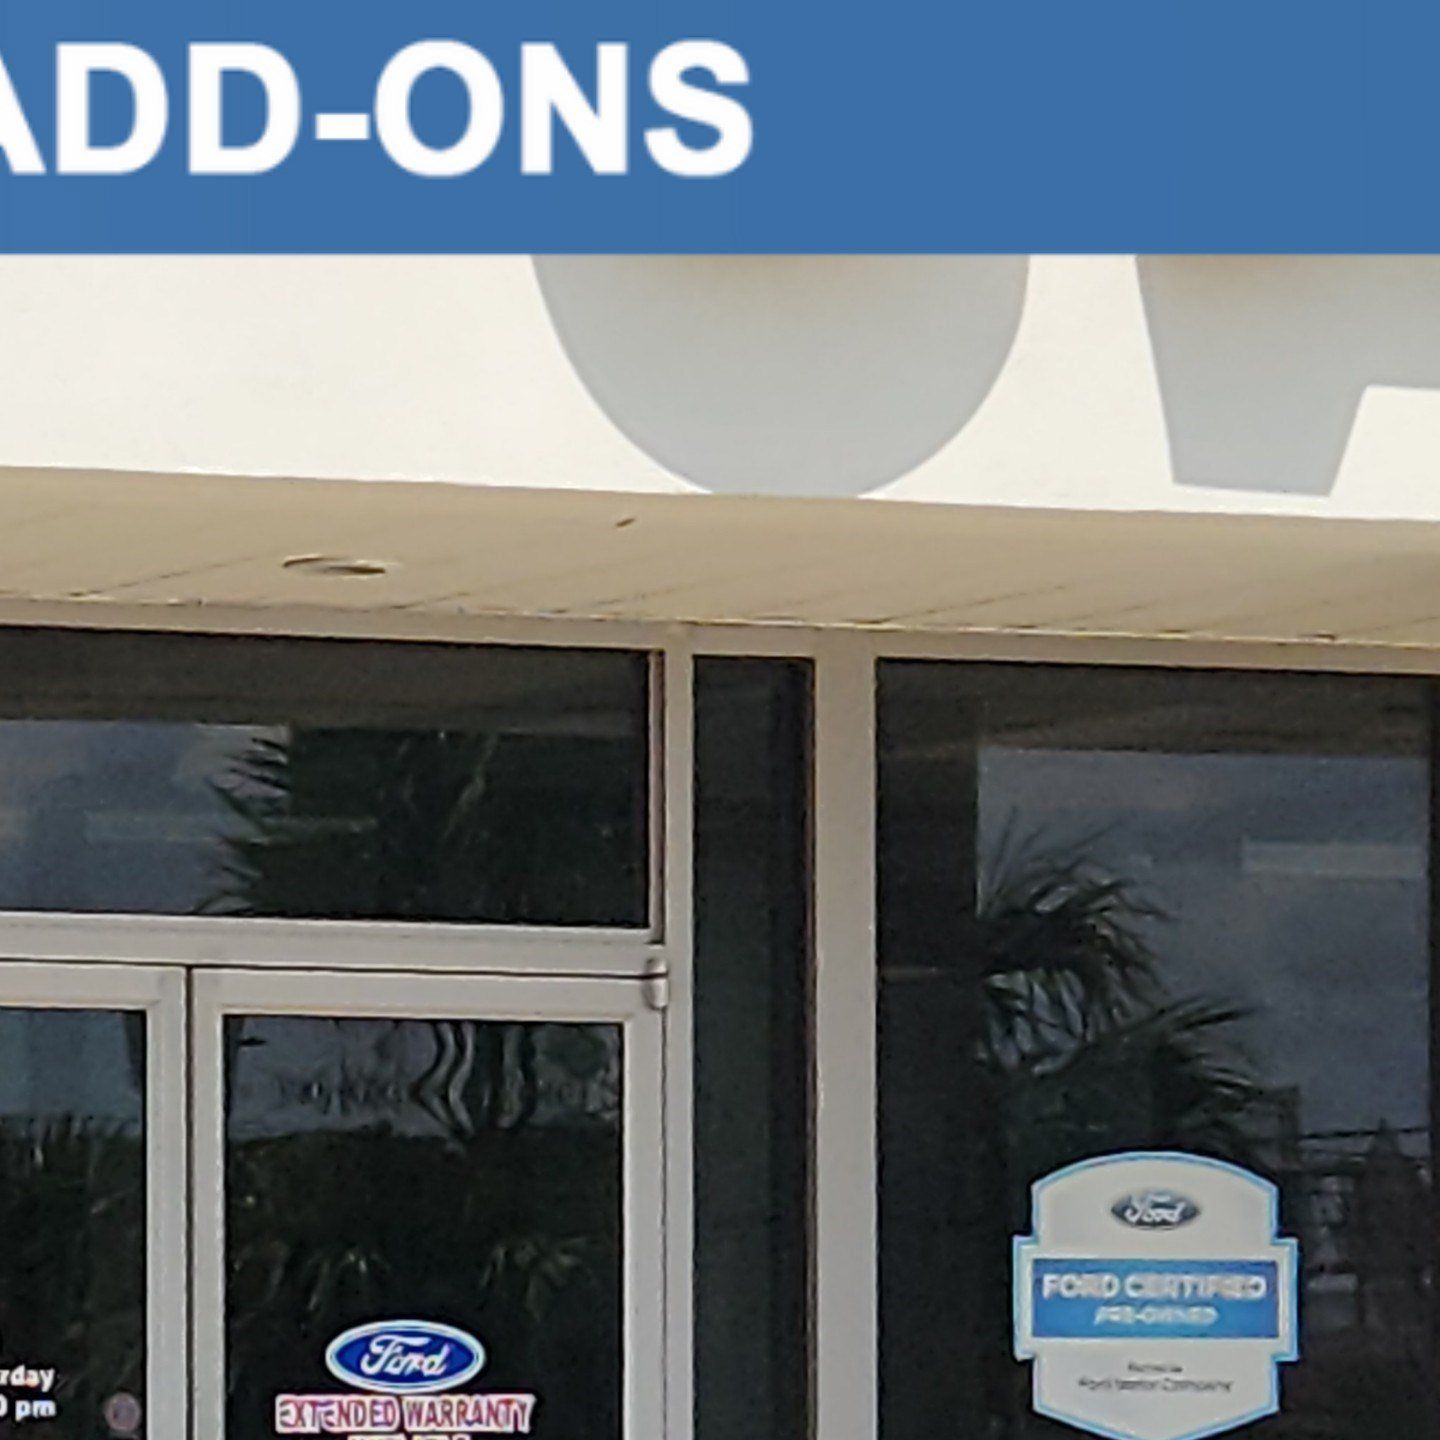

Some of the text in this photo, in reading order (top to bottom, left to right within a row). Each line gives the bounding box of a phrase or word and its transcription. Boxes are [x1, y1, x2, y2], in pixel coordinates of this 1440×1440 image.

[1123, 1194, 1187, 1222] Ford
[1042, 1273, 1120, 1298] FORD
[360, 1335, 450, 1376] Ford
[15, 1400, 56, 1421] pm
[278, 1398, 533, 1429] EXTENDED WARRANTY
